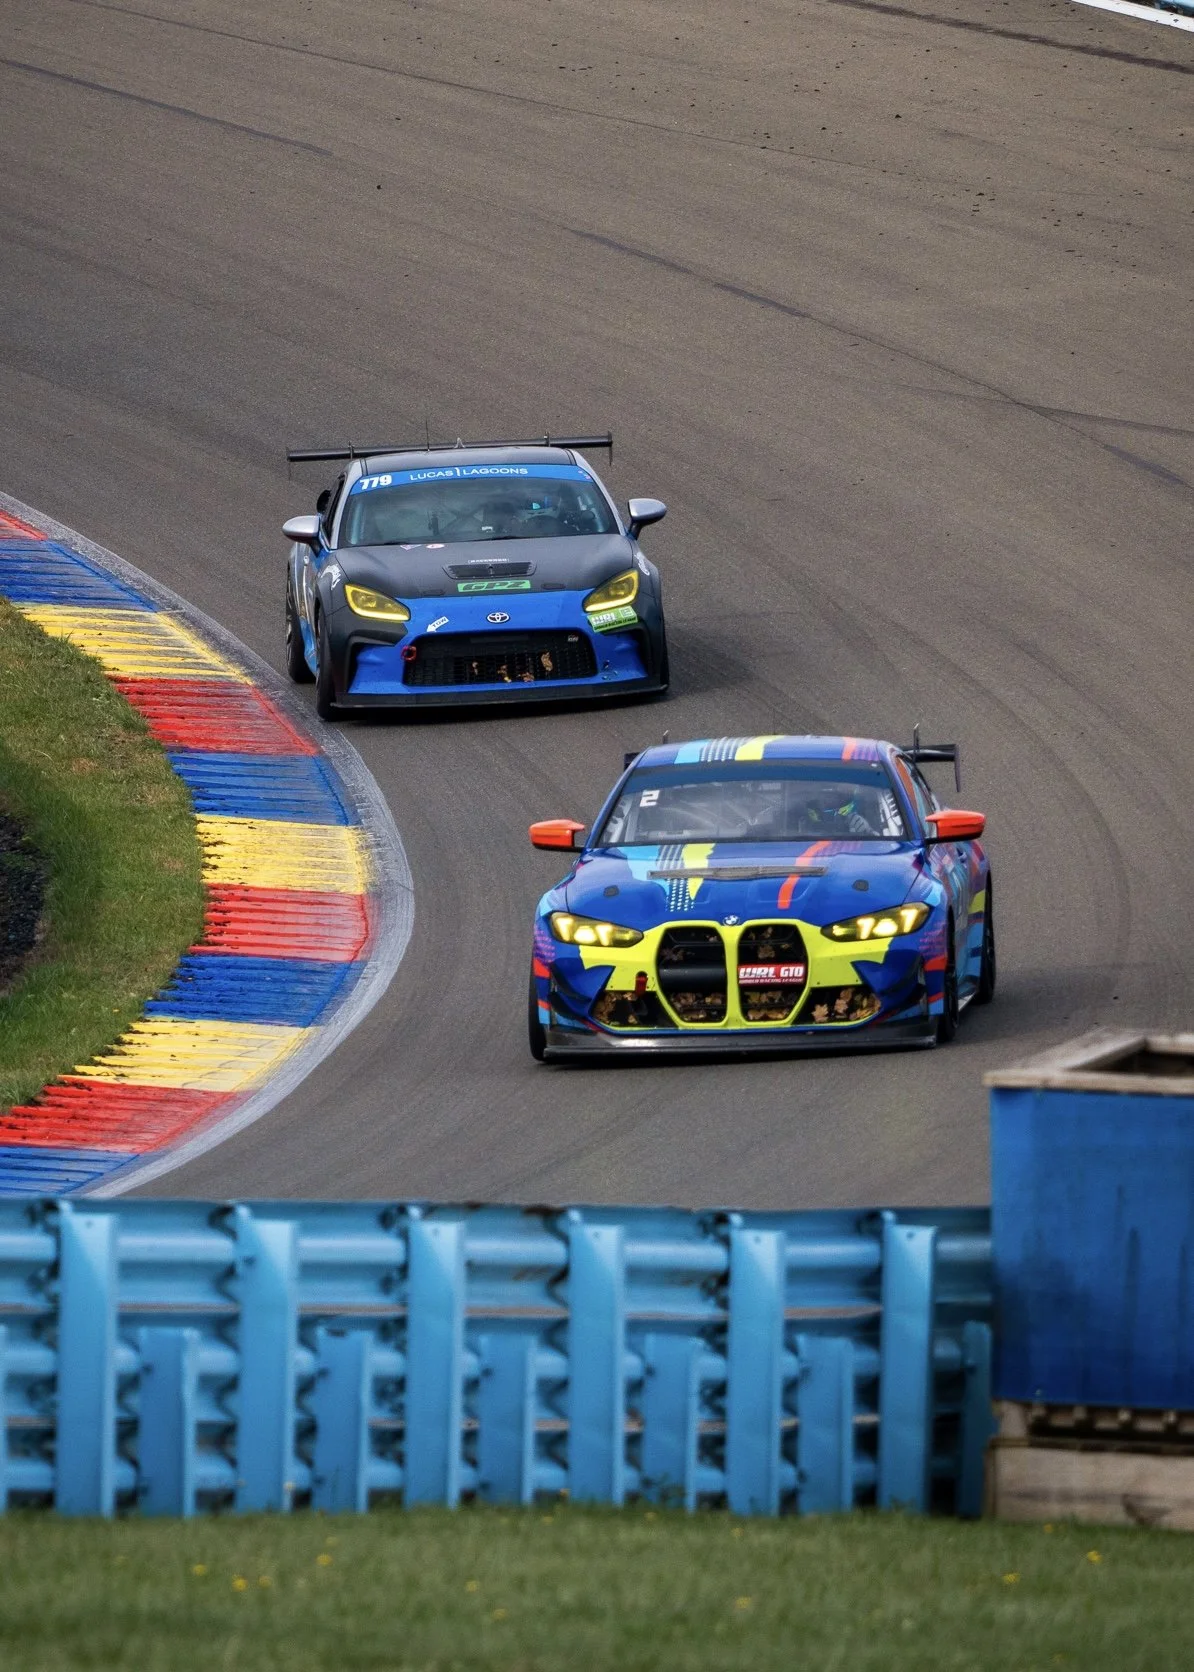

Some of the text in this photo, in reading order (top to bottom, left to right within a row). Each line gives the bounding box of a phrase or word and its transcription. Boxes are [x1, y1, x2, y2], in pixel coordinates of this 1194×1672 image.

[360, 474, 392, 490] 779
[410, 470, 453, 481] LUCAS
[640, 790, 659, 807] 2
[739, 967, 776, 978] WRL
